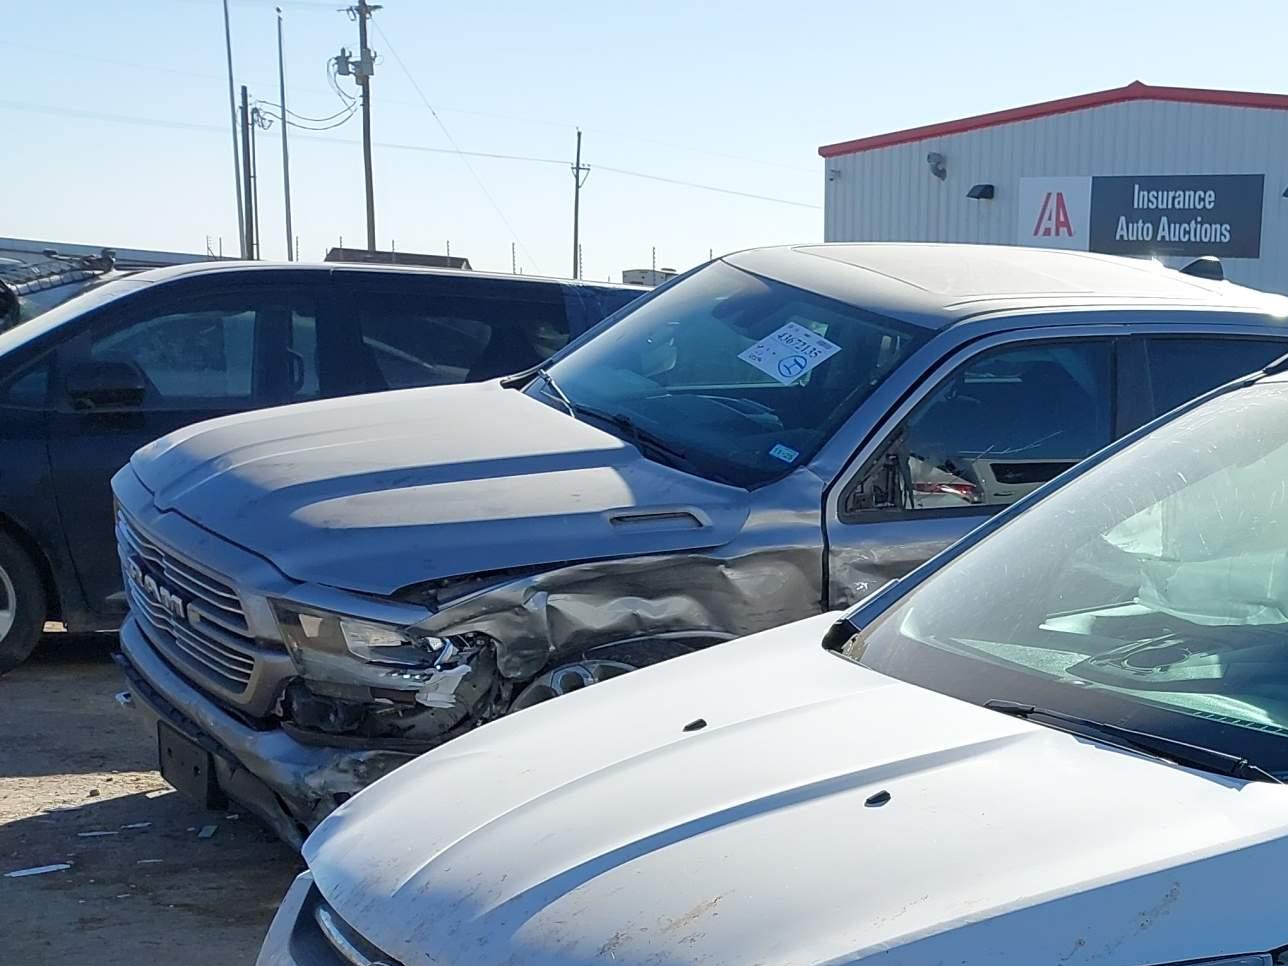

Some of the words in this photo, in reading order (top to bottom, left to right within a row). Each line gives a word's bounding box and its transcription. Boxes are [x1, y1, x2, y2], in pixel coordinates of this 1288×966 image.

[1133, 184, 1215, 209] Insurance
[1116, 216, 1153, 241] Auto
[1157, 216, 1231, 243] Auctions
[127, 557, 185, 618] RAM
